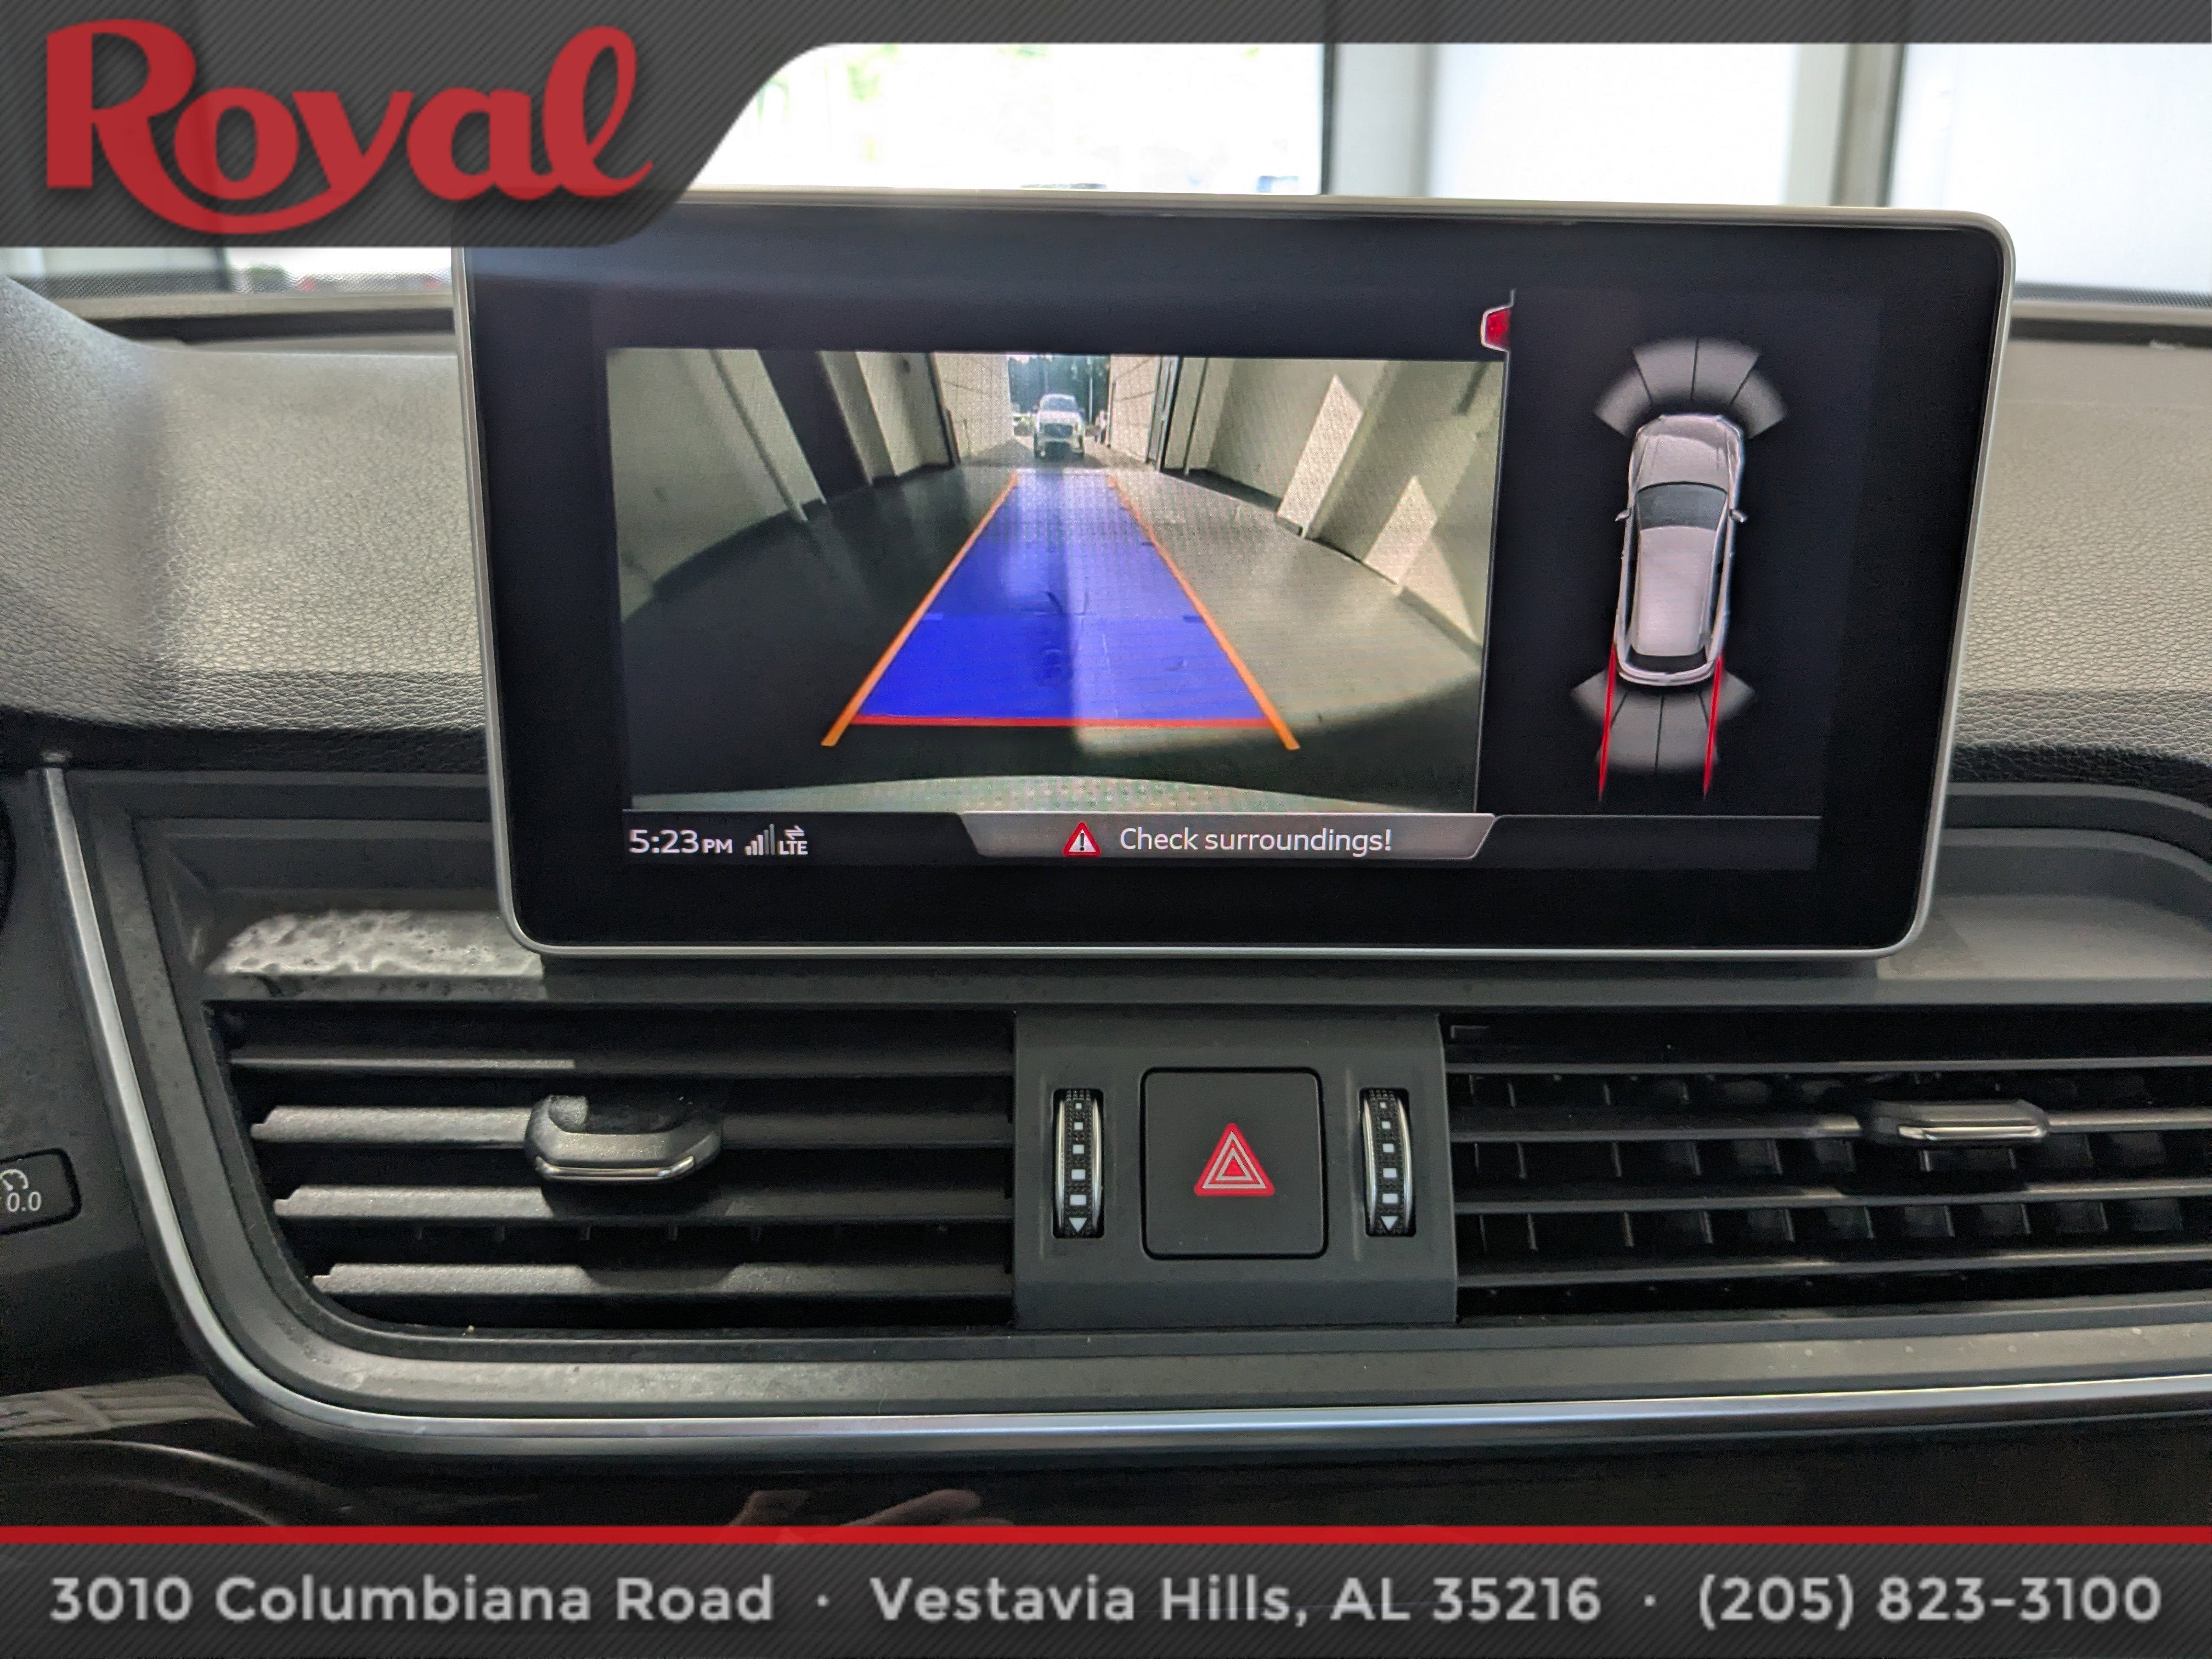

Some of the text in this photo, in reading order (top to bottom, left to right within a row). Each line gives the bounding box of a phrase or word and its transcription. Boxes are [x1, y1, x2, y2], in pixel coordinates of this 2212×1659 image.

[778, 840, 809, 856] LTE
[1120, 826, 1392, 857] Check surroundings!
[7, 1191, 42, 1212] 0.0
